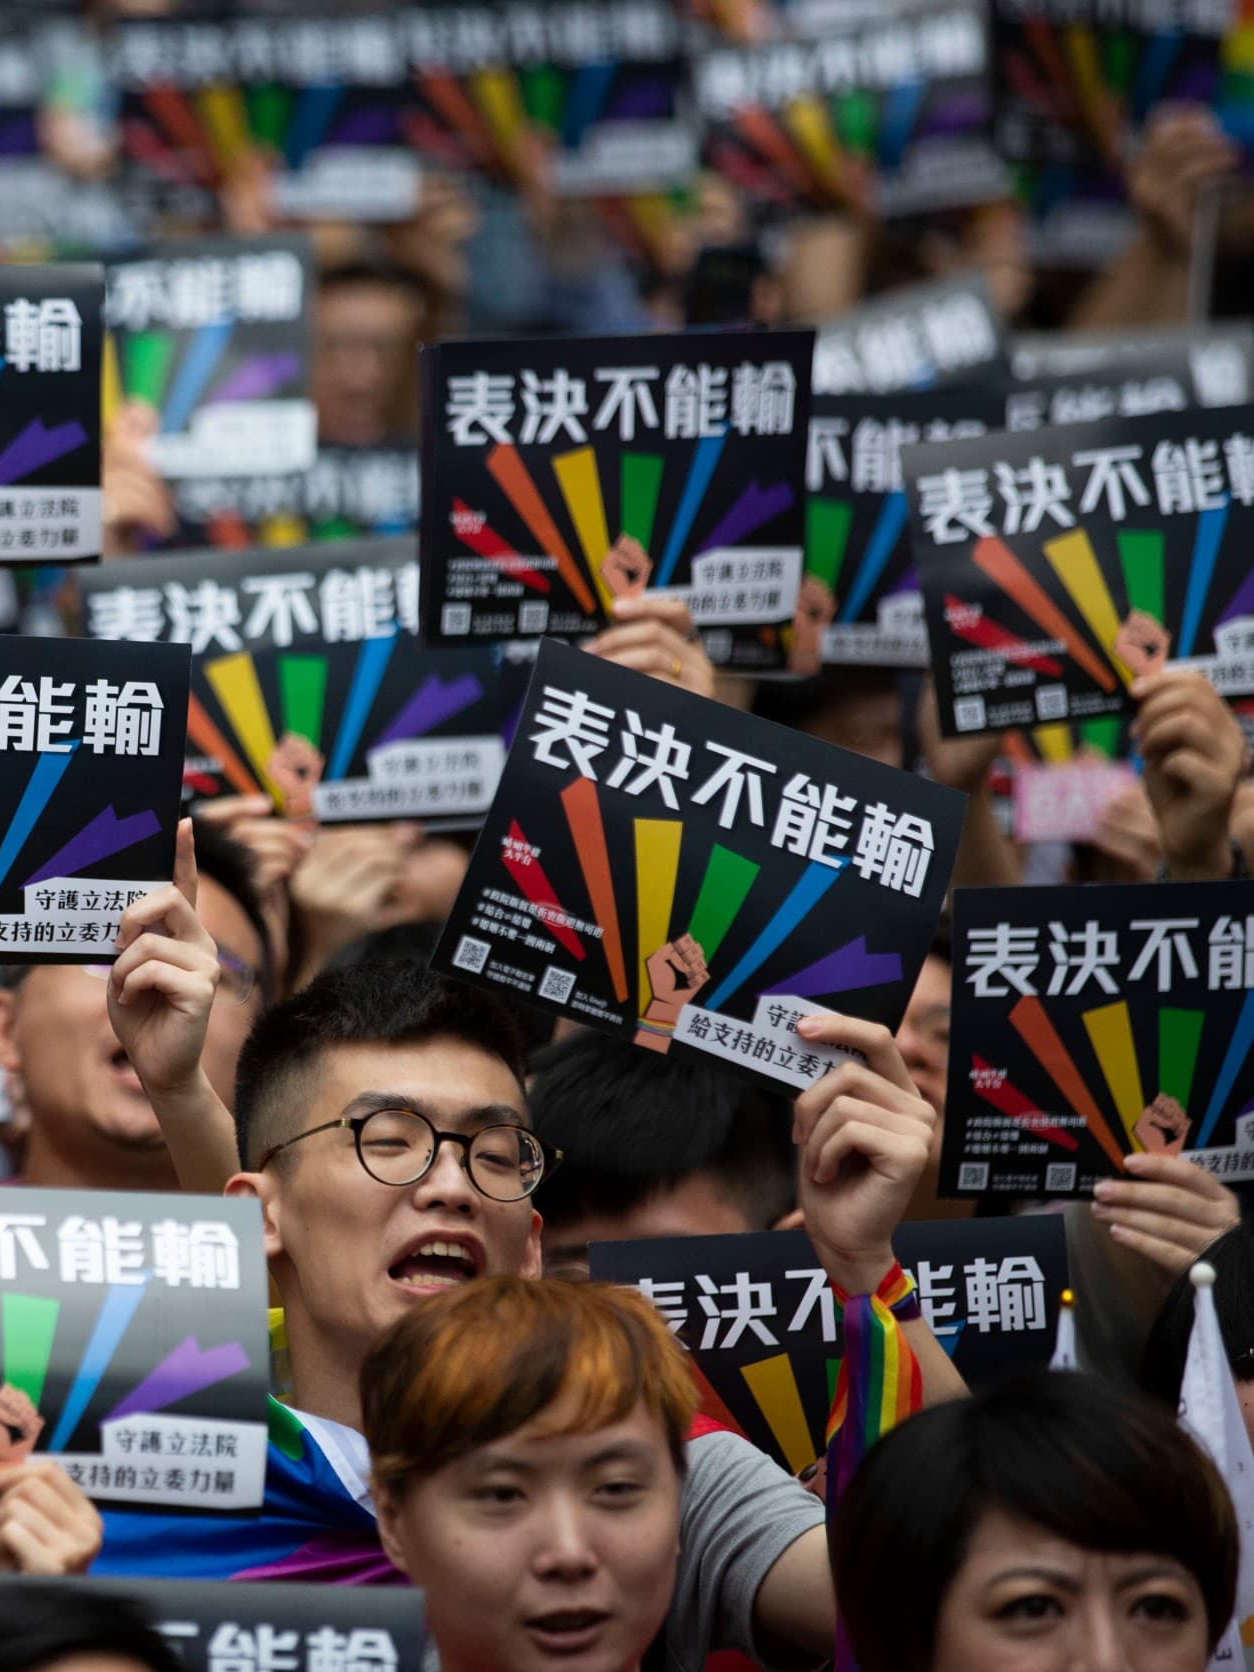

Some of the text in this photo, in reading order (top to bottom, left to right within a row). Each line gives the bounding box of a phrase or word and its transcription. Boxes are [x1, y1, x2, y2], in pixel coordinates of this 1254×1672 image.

[446, 360, 798, 447] 表決不能輸
[87, 563, 420, 656] 表決不能
[529, 686, 936, 899] 表決不能輸
[965, 914, 1254, 998] 表決不能
[116, 1429, 239, 1458] 守護立法院
[156, 1621, 399, 1672] 能輸
